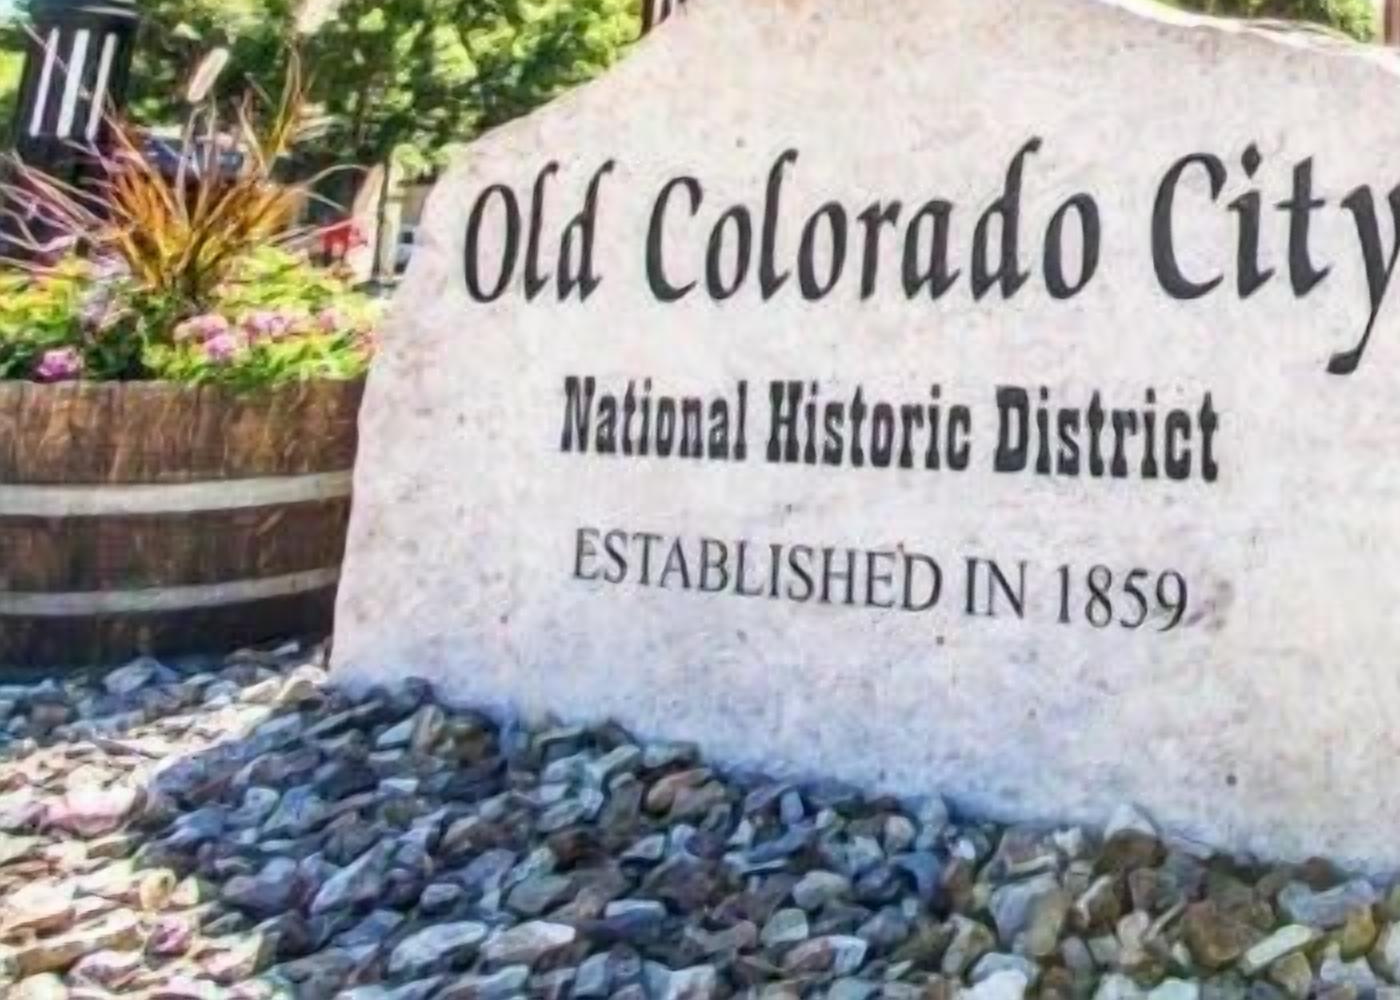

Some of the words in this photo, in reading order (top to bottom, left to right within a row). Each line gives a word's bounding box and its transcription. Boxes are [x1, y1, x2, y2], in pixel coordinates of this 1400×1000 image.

[463, 158, 614, 304] Old
[645, 136, 1101, 303] Colorado
[560, 375, 748, 462] National
[765, 379, 972, 472] Historic
[993, 385, 1220, 483] District
[573, 527, 943, 612] ESTABLISHED
[964, 558, 1027, 619] IN
[1056, 564, 1188, 632] 1859
